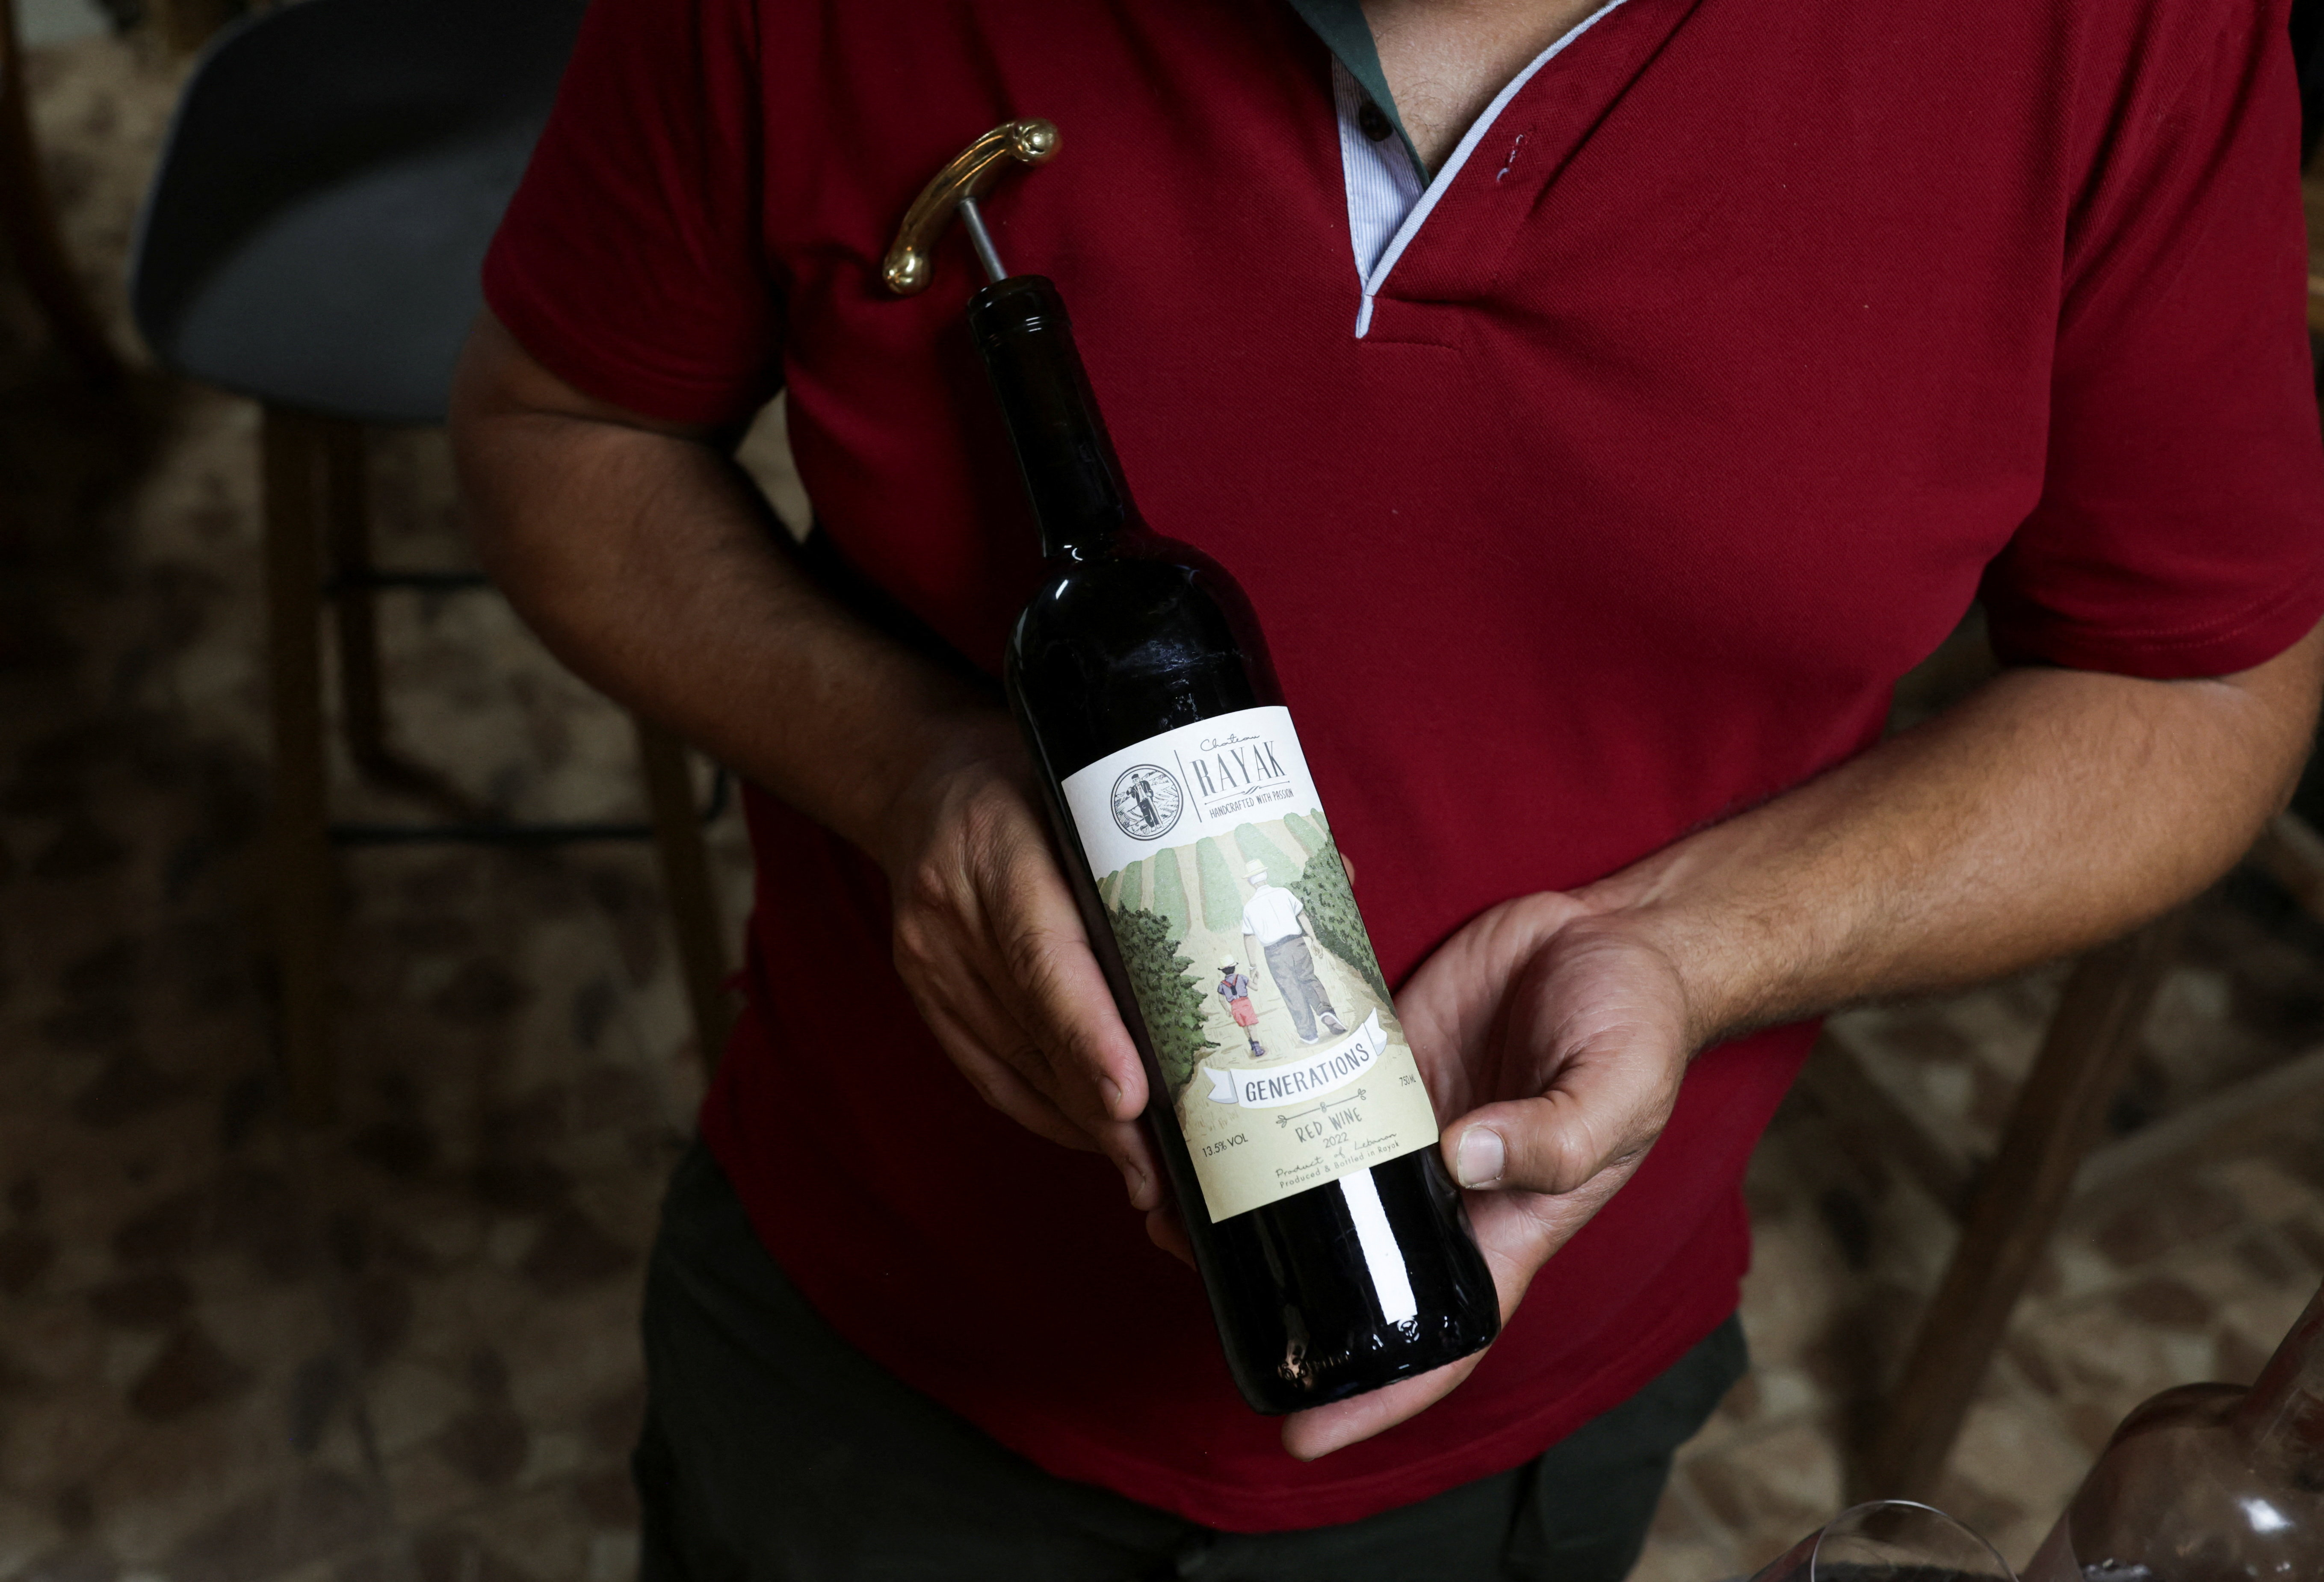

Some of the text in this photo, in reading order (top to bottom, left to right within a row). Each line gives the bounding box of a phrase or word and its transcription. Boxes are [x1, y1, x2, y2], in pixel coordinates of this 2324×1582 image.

[1189, 741, 1286, 798] RAYAK
[1209, 788, 1294, 818] HANDCRAFTED WITH PASSION
[1246, 1043, 1369, 1102] GENERATIONS
[1295, 1107, 1362, 1143] RED WINE
[1323, 1132, 1348, 1148] 2022
[1202, 1133, 1248, 1157] 13.5% VOL
[1275, 1133, 1397, 1178] Product of Lebanon
[1280, 1168, 1321, 1188] Produced
[1334, 1154, 1364, 1169] Bottled
